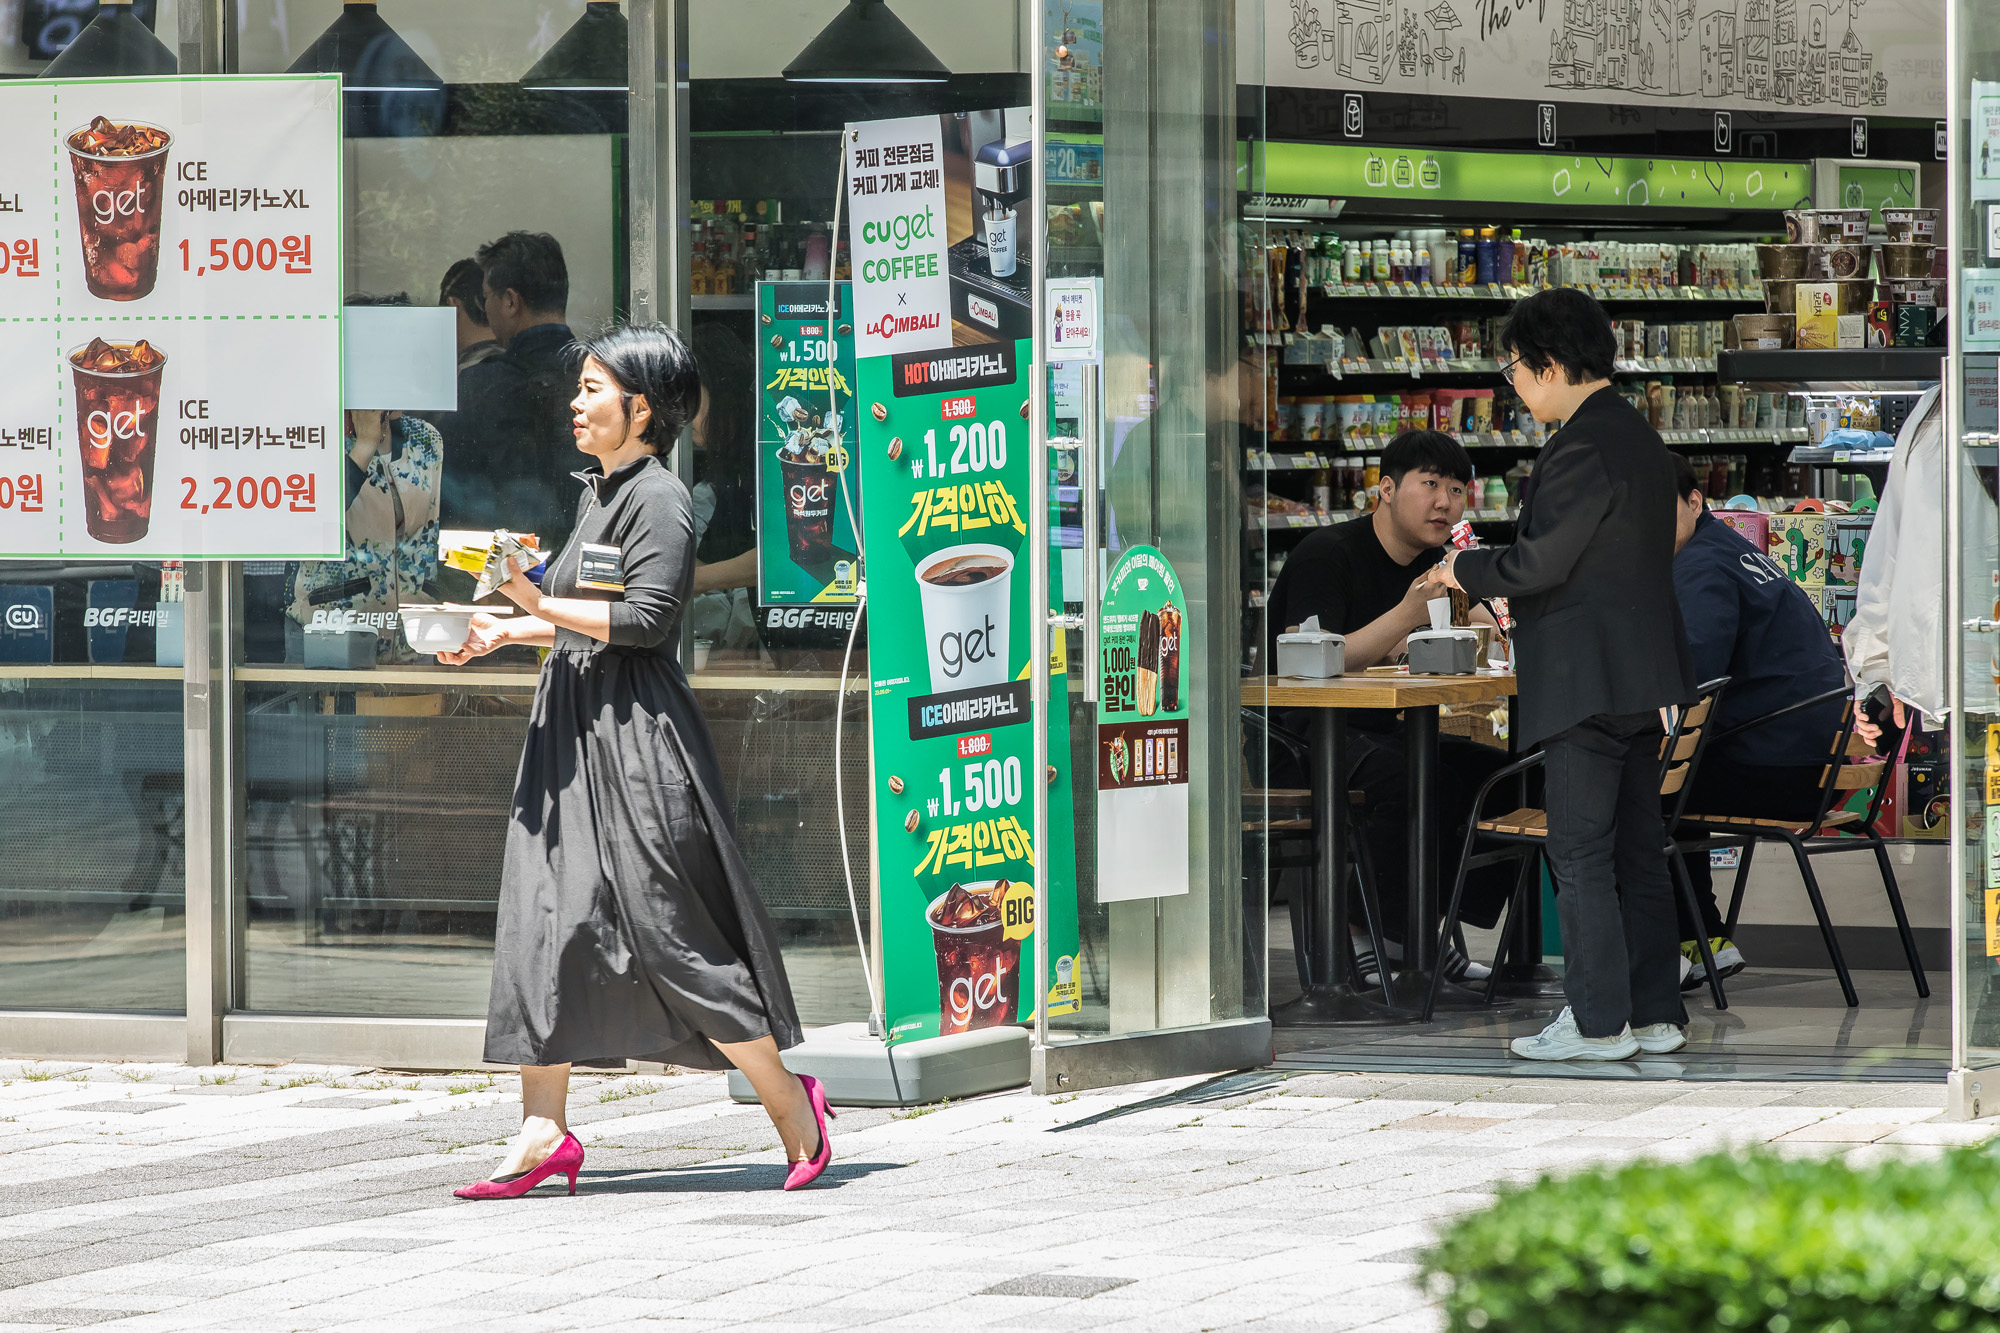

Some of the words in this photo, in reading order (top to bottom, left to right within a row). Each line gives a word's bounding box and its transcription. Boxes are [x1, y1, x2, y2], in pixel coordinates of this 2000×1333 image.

[177, 161, 208, 182] ICE
[855, 147, 879, 169] 커피
[883, 142, 934, 167] 전문점급
[853, 175, 878, 196] 커피
[880, 171, 907, 193] 기계
[909, 168, 940, 191] 교체!
[92, 180, 145, 225] get
[178, 187, 310, 213] 아메리카노XL
[989, 228, 1007, 246] get
[990, 246, 1008, 254] COFFEE
[178, 234, 313, 278] 1,500원
[862, 252, 939, 284] COFFEE
[1813, 291, 1822, 317] 보리차
[903, 353, 1008, 385] HOT아메리카노L
[87, 400, 146, 449] get
[179, 400, 210, 420] ICE
[179, 426, 326, 450] 아메리카노벤티
[911, 420, 1008, 479] ₩1,200
[180, 473, 317, 514] 2,200원
[790, 478, 829, 508] get
[898, 480, 1027, 539] 가격인하
[11, 610, 32, 623] CU
[939, 614, 996, 679] get
[1103, 647, 1136, 674] 1,000원
[1161, 632, 1178, 657] get
[1104, 674, 1136, 713] 할인
[921, 692, 1019, 728] ICE아메리카노L
[927, 756, 1022, 818] ₩1,500
[914, 815, 1035, 878] 가격인하
[1006, 895, 1034, 927] BIG
[949, 956, 1008, 1027] get
